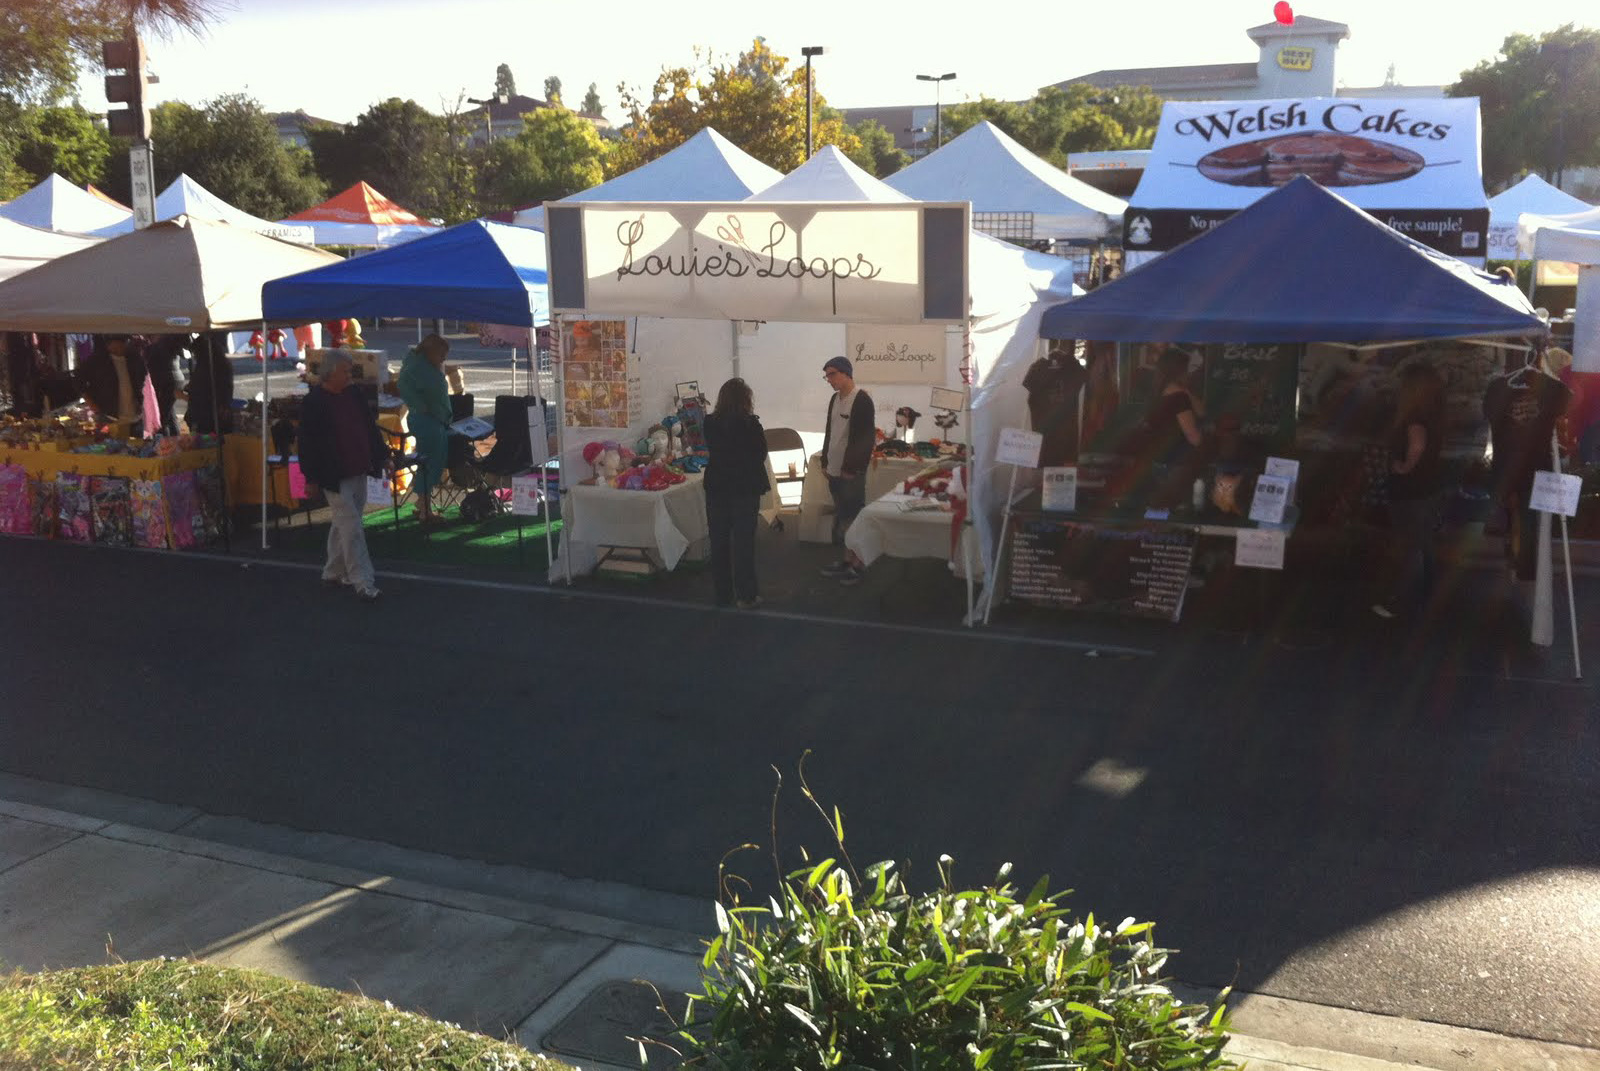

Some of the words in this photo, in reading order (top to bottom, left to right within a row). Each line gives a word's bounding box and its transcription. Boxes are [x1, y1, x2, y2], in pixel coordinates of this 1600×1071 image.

[1175, 102, 1308, 142] Welsh
[1322, 103, 1451, 141] Cakes
[1190, 215, 1208, 229] No
[1415, 216, 1463, 237] sample!
[617, 220, 750, 282] Louie's
[756, 220, 882, 316] Loops
[898, 344, 937, 372] Loops
